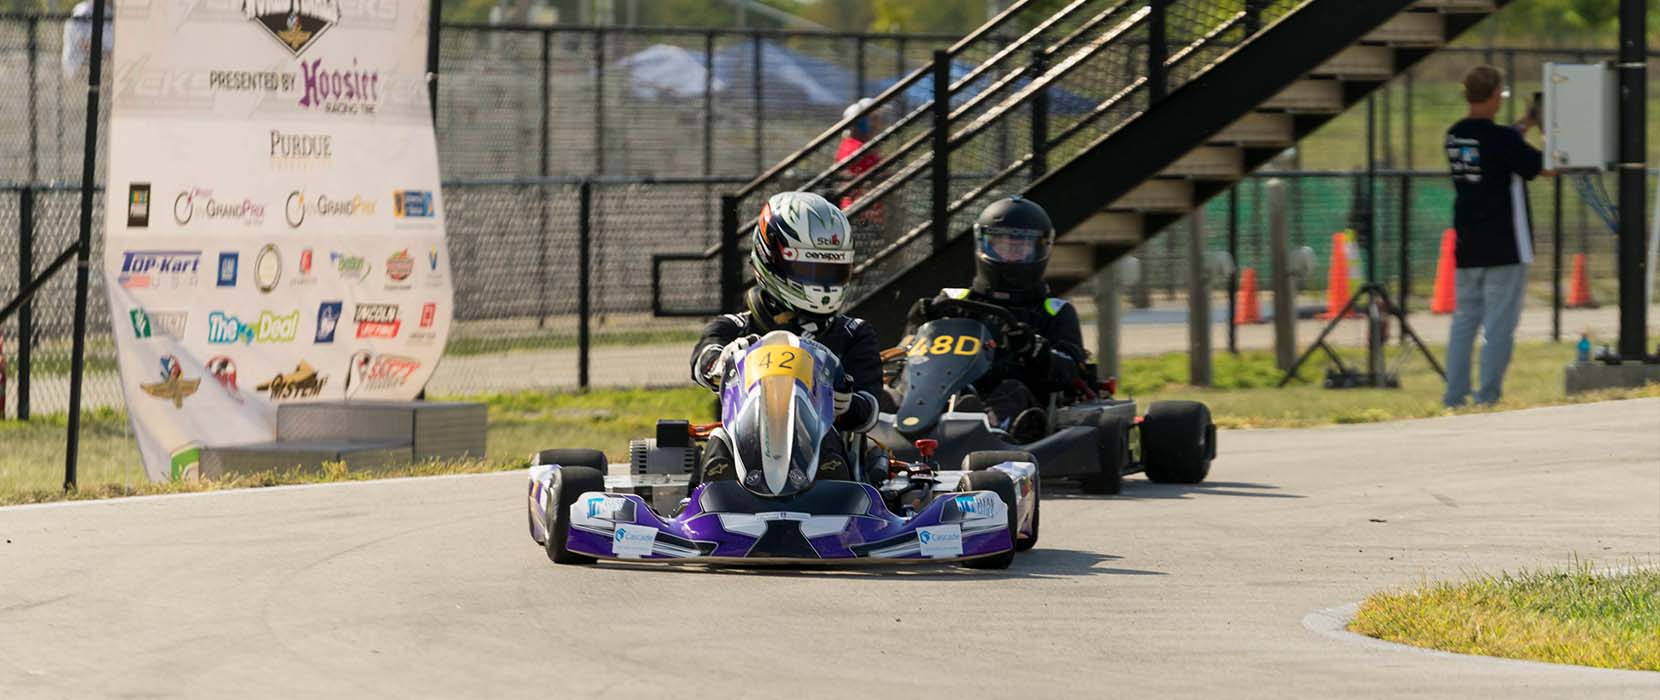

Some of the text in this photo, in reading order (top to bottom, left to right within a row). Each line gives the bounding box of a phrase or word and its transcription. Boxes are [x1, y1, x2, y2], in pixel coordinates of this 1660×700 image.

[209, 71, 296, 92] PRESENTED BY
[299, 57, 379, 107] Hoosier
[270, 130, 332, 158] PURDUE
[209, 312, 240, 343] The
[257, 310, 299, 342] Deal
[906, 335, 980, 356] 48D
[758, 351, 796, 370] 42
